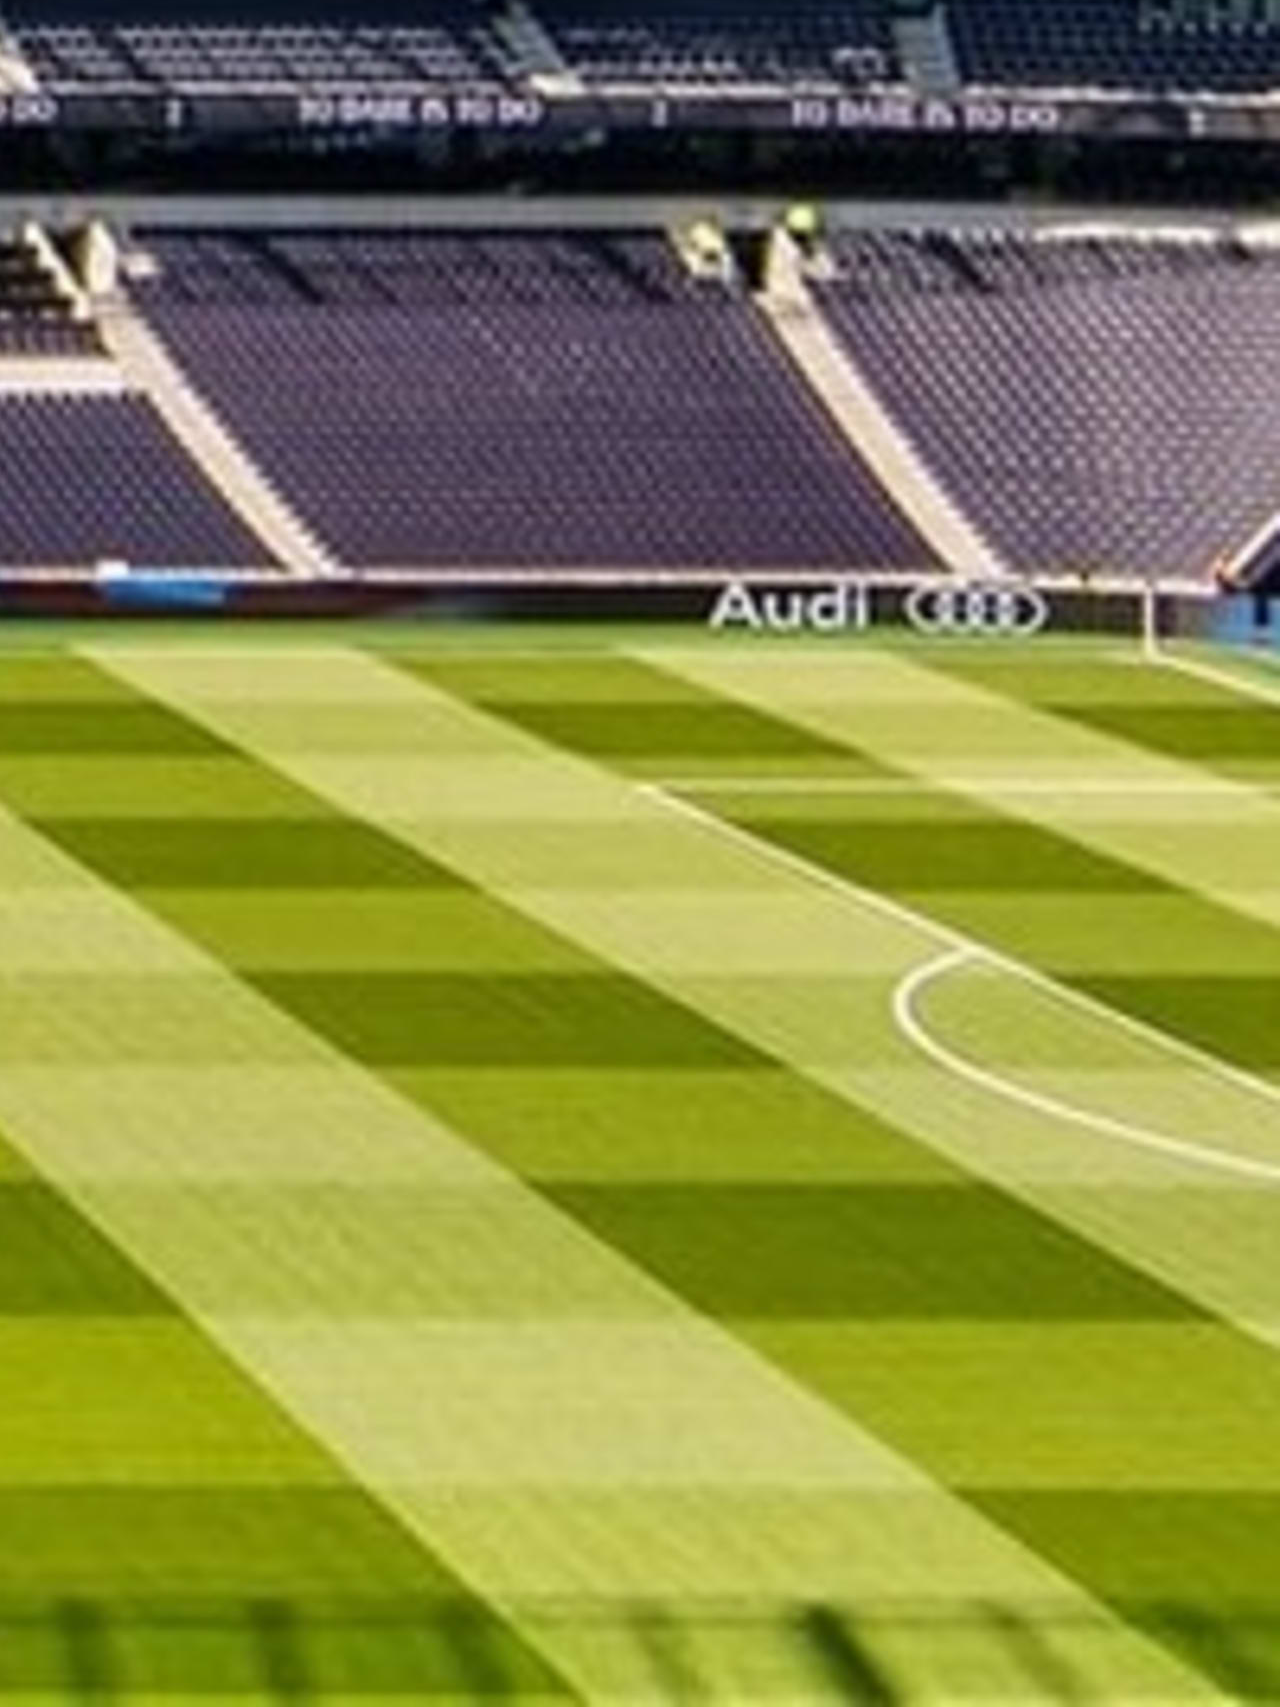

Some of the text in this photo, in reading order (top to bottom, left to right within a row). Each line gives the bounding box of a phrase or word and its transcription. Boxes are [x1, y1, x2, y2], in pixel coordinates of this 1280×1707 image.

[11, 96, 58, 123] DO
[298, 97, 334, 124] TO
[456, 97, 494, 124] TO
[497, 97, 544, 124] DO
[791, 99, 828, 127] TO
[963, 102, 1005, 130] TO
[1009, 102, 1058, 130] DO
[708, 581, 867, 629] Audi
